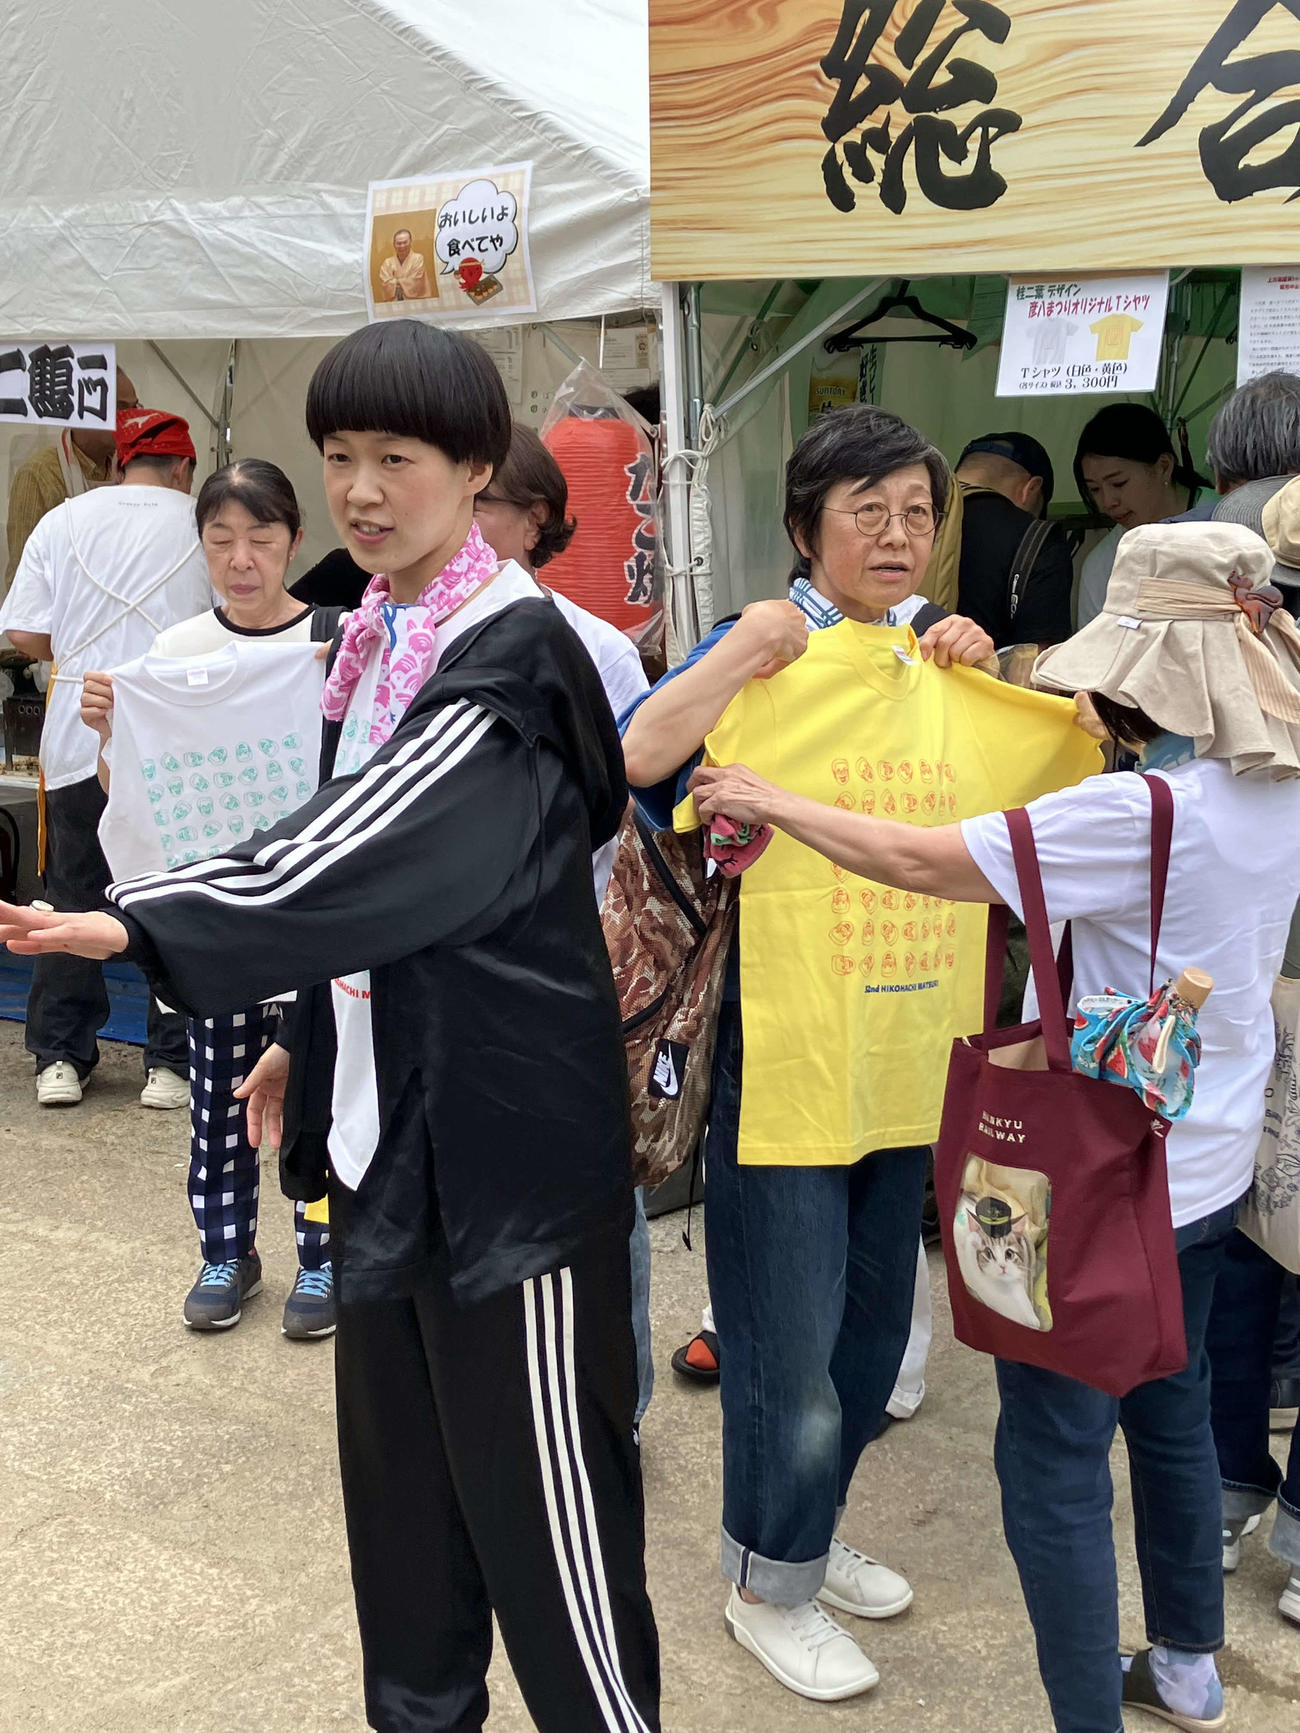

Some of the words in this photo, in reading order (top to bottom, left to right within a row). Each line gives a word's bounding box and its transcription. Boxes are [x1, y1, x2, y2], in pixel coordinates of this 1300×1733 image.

[439, 205, 509, 229] おいしいよ
[447, 234, 503, 256] 食べてや
[1016, 284, 1045, 300] 桂二葉
[1047, 283, 1081, 298] デザイン
[979, 1122, 1026, 1143] RAILWAY
